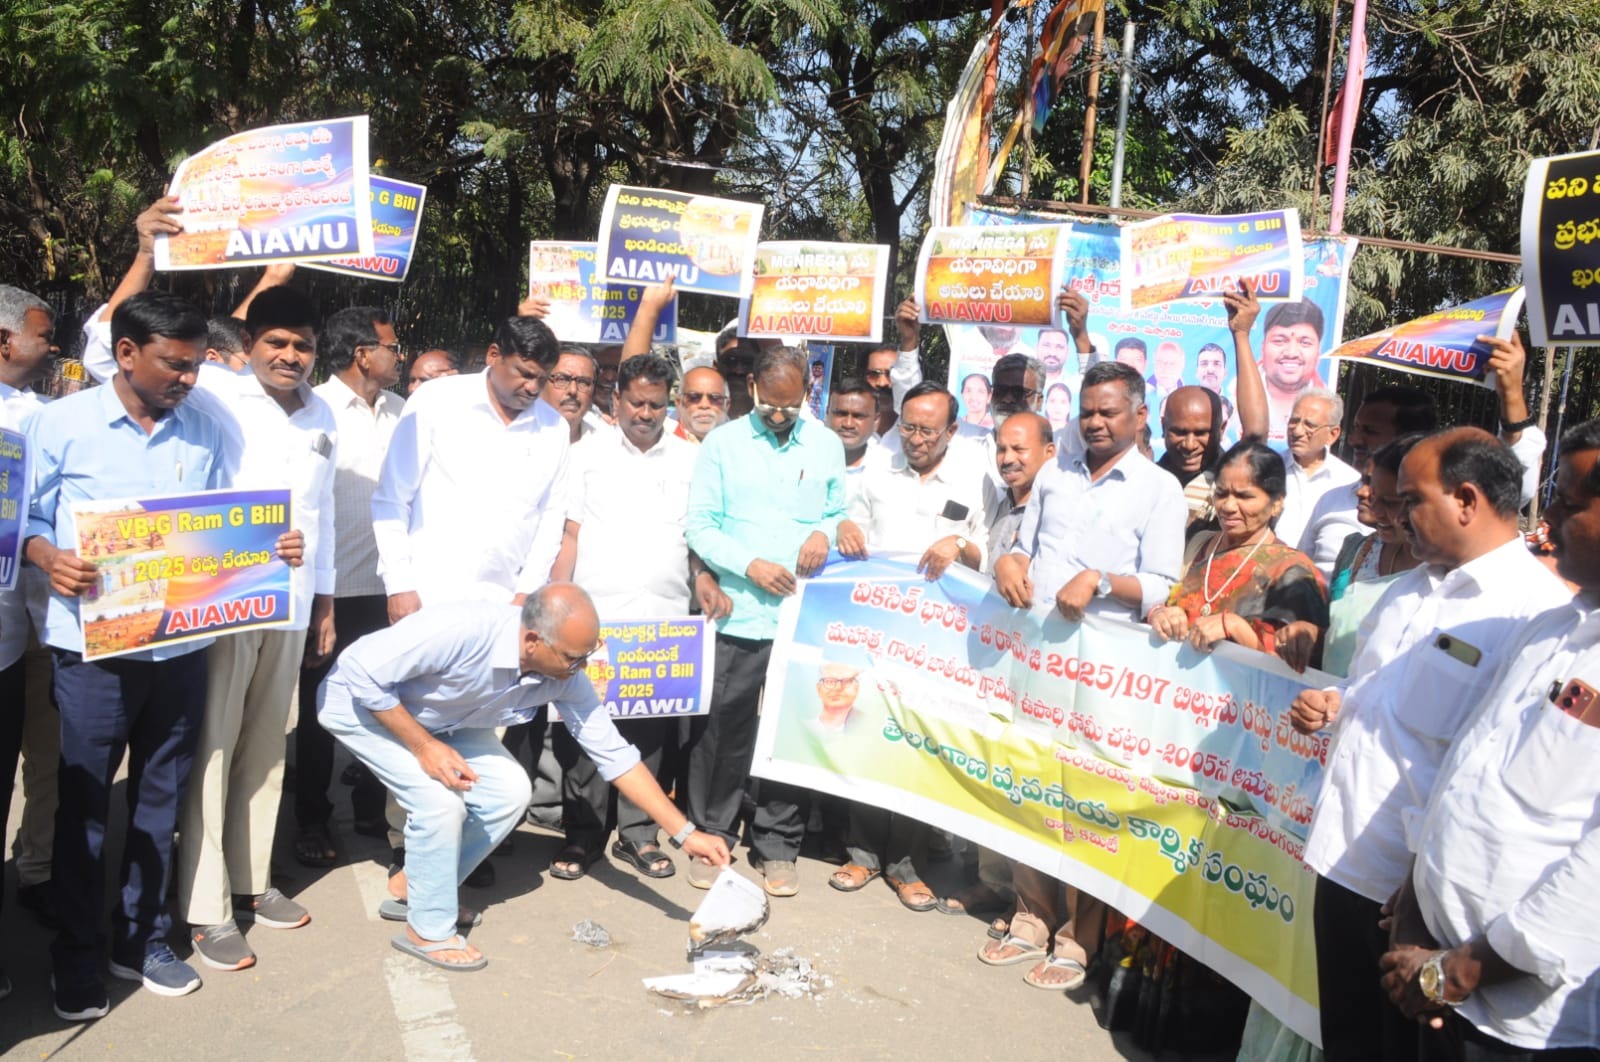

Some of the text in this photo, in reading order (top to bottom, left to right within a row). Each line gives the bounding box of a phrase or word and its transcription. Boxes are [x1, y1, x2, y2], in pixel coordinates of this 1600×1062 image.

[1546, 177, 1589, 200] పని
[378, 190, 390, 206] G
[392, 193, 416, 211] Bill
[1199, 223, 1233, 236] Ram
[1238, 223, 1250, 234] G
[1254, 218, 1281, 232] Bill
[225, 222, 348, 257] AIAWU
[949, 236, 1026, 250] MGNREGA
[608, 256, 699, 285] AIAWU
[771, 254, 847, 269] MGNREGA
[552, 285, 639, 301] VB-G Ram G
[939, 280, 1045, 301] అమలు చేయాలి
[1189, 273, 1281, 295] AIAWU
[591, 305, 626, 319] 2025
[929, 301, 1013, 322] AIAWU
[750, 314, 833, 334] AIAWU
[1379, 339, 1478, 373] AIAWU
[2, 499, 18, 521] Bill
[117, 504, 285, 540] VB-G Ram G Bill
[134, 549, 271, 583] 2025 రద్దు చేయాలి
[165, 595, 277, 635] AIAWU
[620, 664, 652, 679] Ram
[656, 664, 667, 678] G
[671, 662, 694, 678] Bill
[853, 583, 921, 614] వికసిత్
[920, 600, 968, 632] భారత్
[1046, 652, 1171, 705] 2025/197
[1173, 686, 1239, 728] బిల్లును
[1242, 701, 1273, 752] రద్దు
[618, 683, 654, 698] 2025
[604, 697, 694, 717] AIAWU
[888, 640, 927, 669] గాంధీ
[927, 656, 977, 687] జాతీయ
[1021, 692, 1065, 728] ఉపాధి
[1068, 711, 1104, 742] హామీ
[1231, 768, 1280, 806] అమలు
[883, 717, 1295, 922] తెలంగాణ వ్యవసాయ కార్మిక సంఘం
